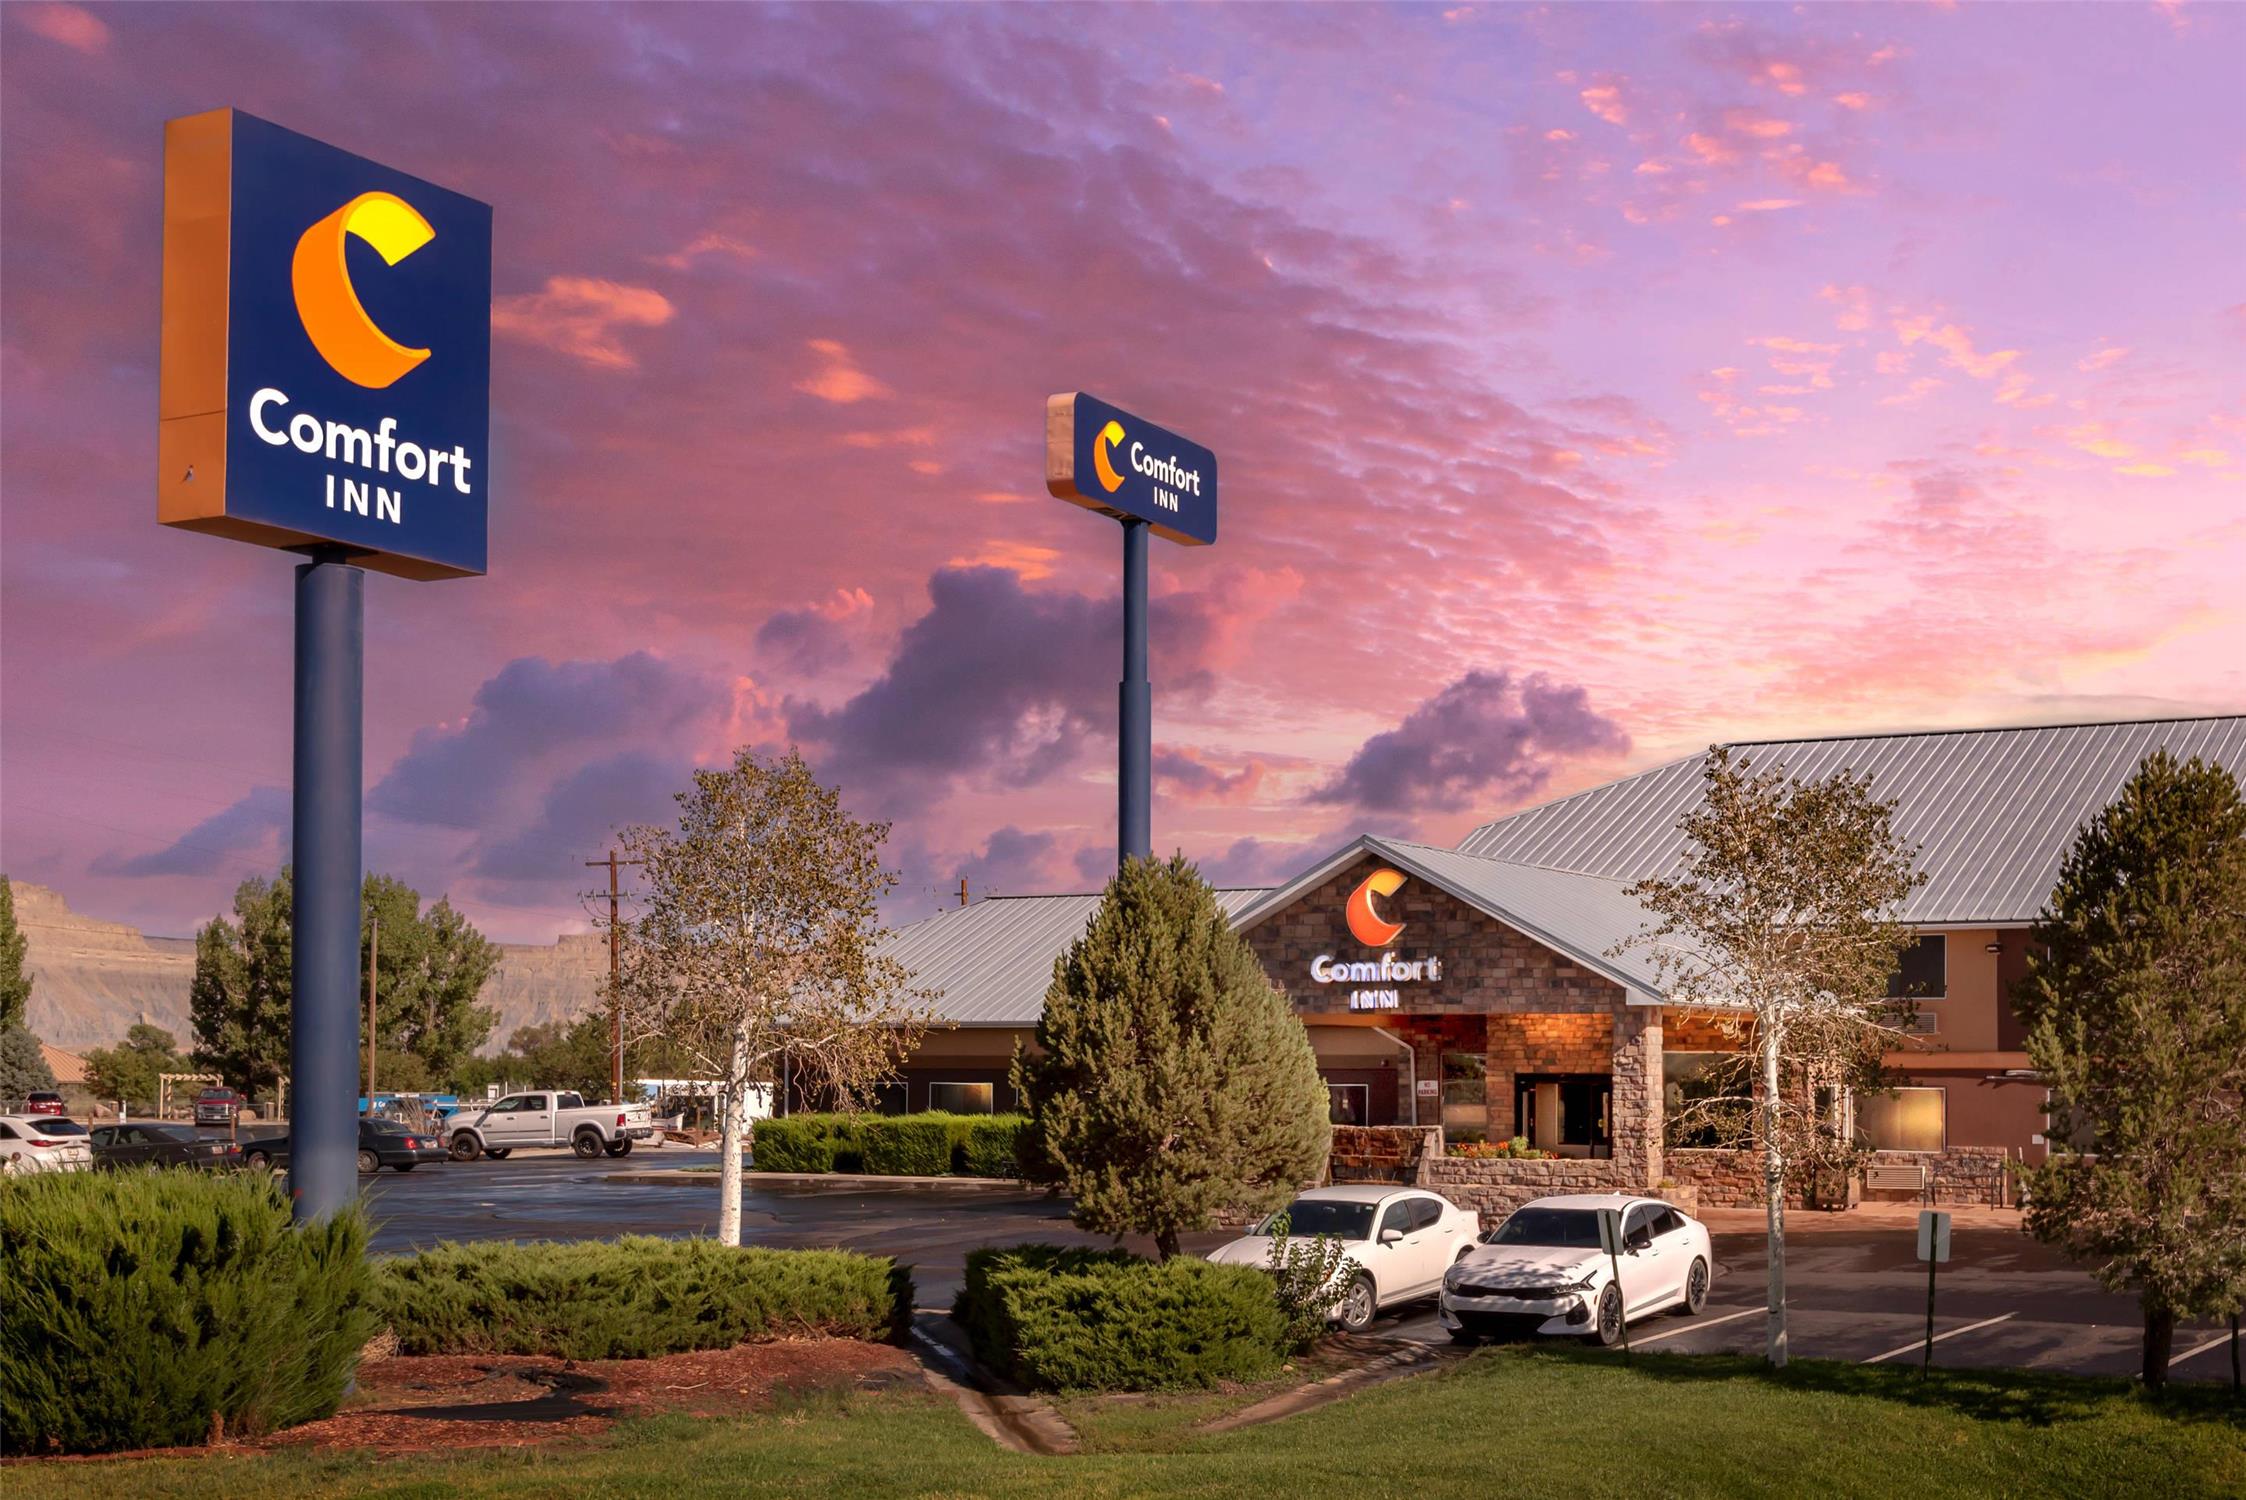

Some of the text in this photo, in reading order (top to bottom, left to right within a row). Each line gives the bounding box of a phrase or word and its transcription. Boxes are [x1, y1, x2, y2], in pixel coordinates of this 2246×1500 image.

[249, 387, 472, 494] Comfort
[1130, 441, 1200, 497] Comfort
[326, 474, 402, 525] INN
[1153, 486, 1179, 513] INN
[1310, 951, 1442, 984] Comfort
[1350, 989, 1399, 1009] INN
